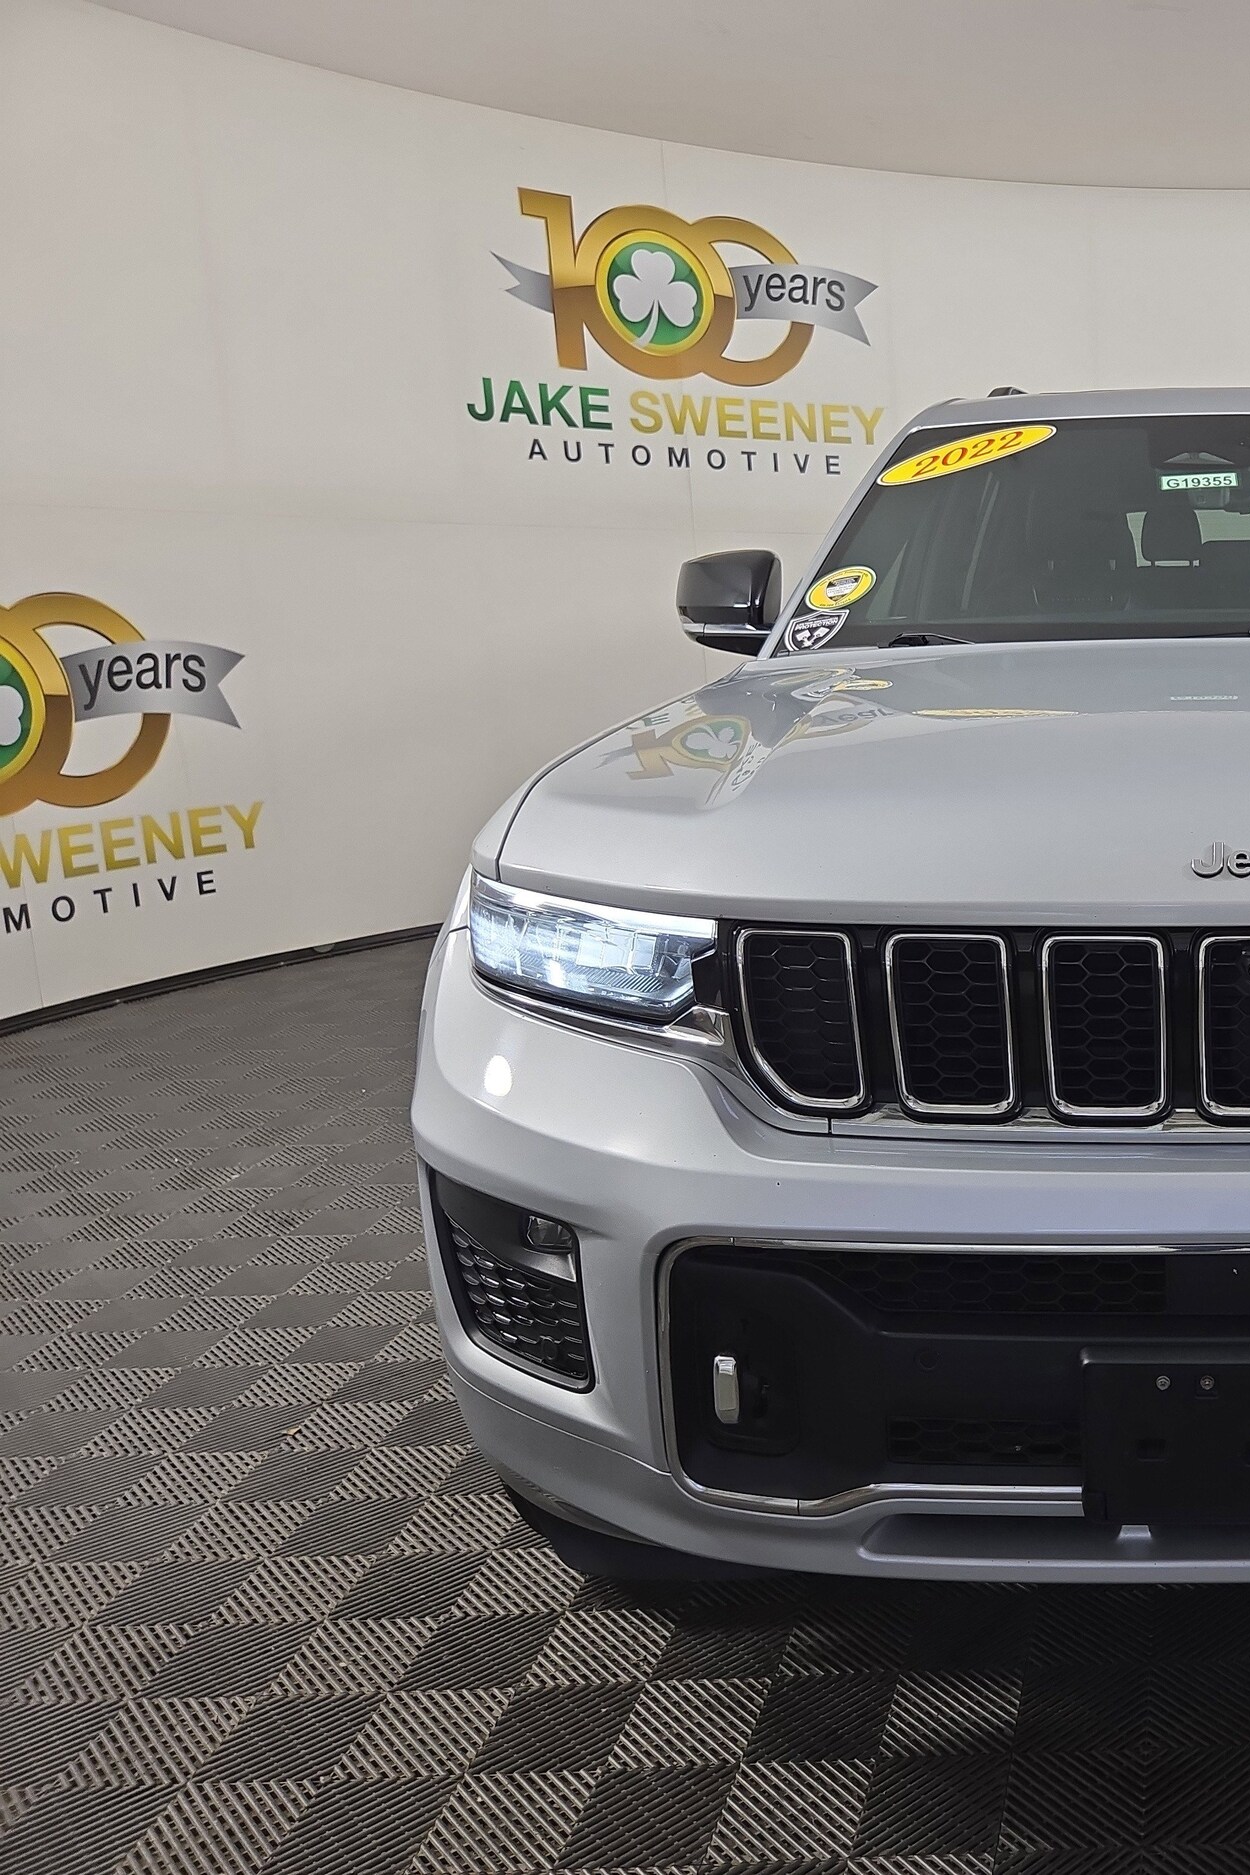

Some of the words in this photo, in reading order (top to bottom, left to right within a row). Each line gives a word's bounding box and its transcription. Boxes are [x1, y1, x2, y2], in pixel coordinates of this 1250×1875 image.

[517, 187, 815, 387] 100
[742, 268, 846, 312] years
[467, 377, 613, 430] JAKE
[629, 391, 885, 445] SWEENEY
[528, 438, 842, 475] AUTOMOTIVE
[911, 431, 1024, 478] 2022
[1165, 475, 1233, 490] G19355
[77, 652, 207, 711] years
[0, 800, 264, 889] WEENEY
[2, 870, 217, 934] MOTIVE
